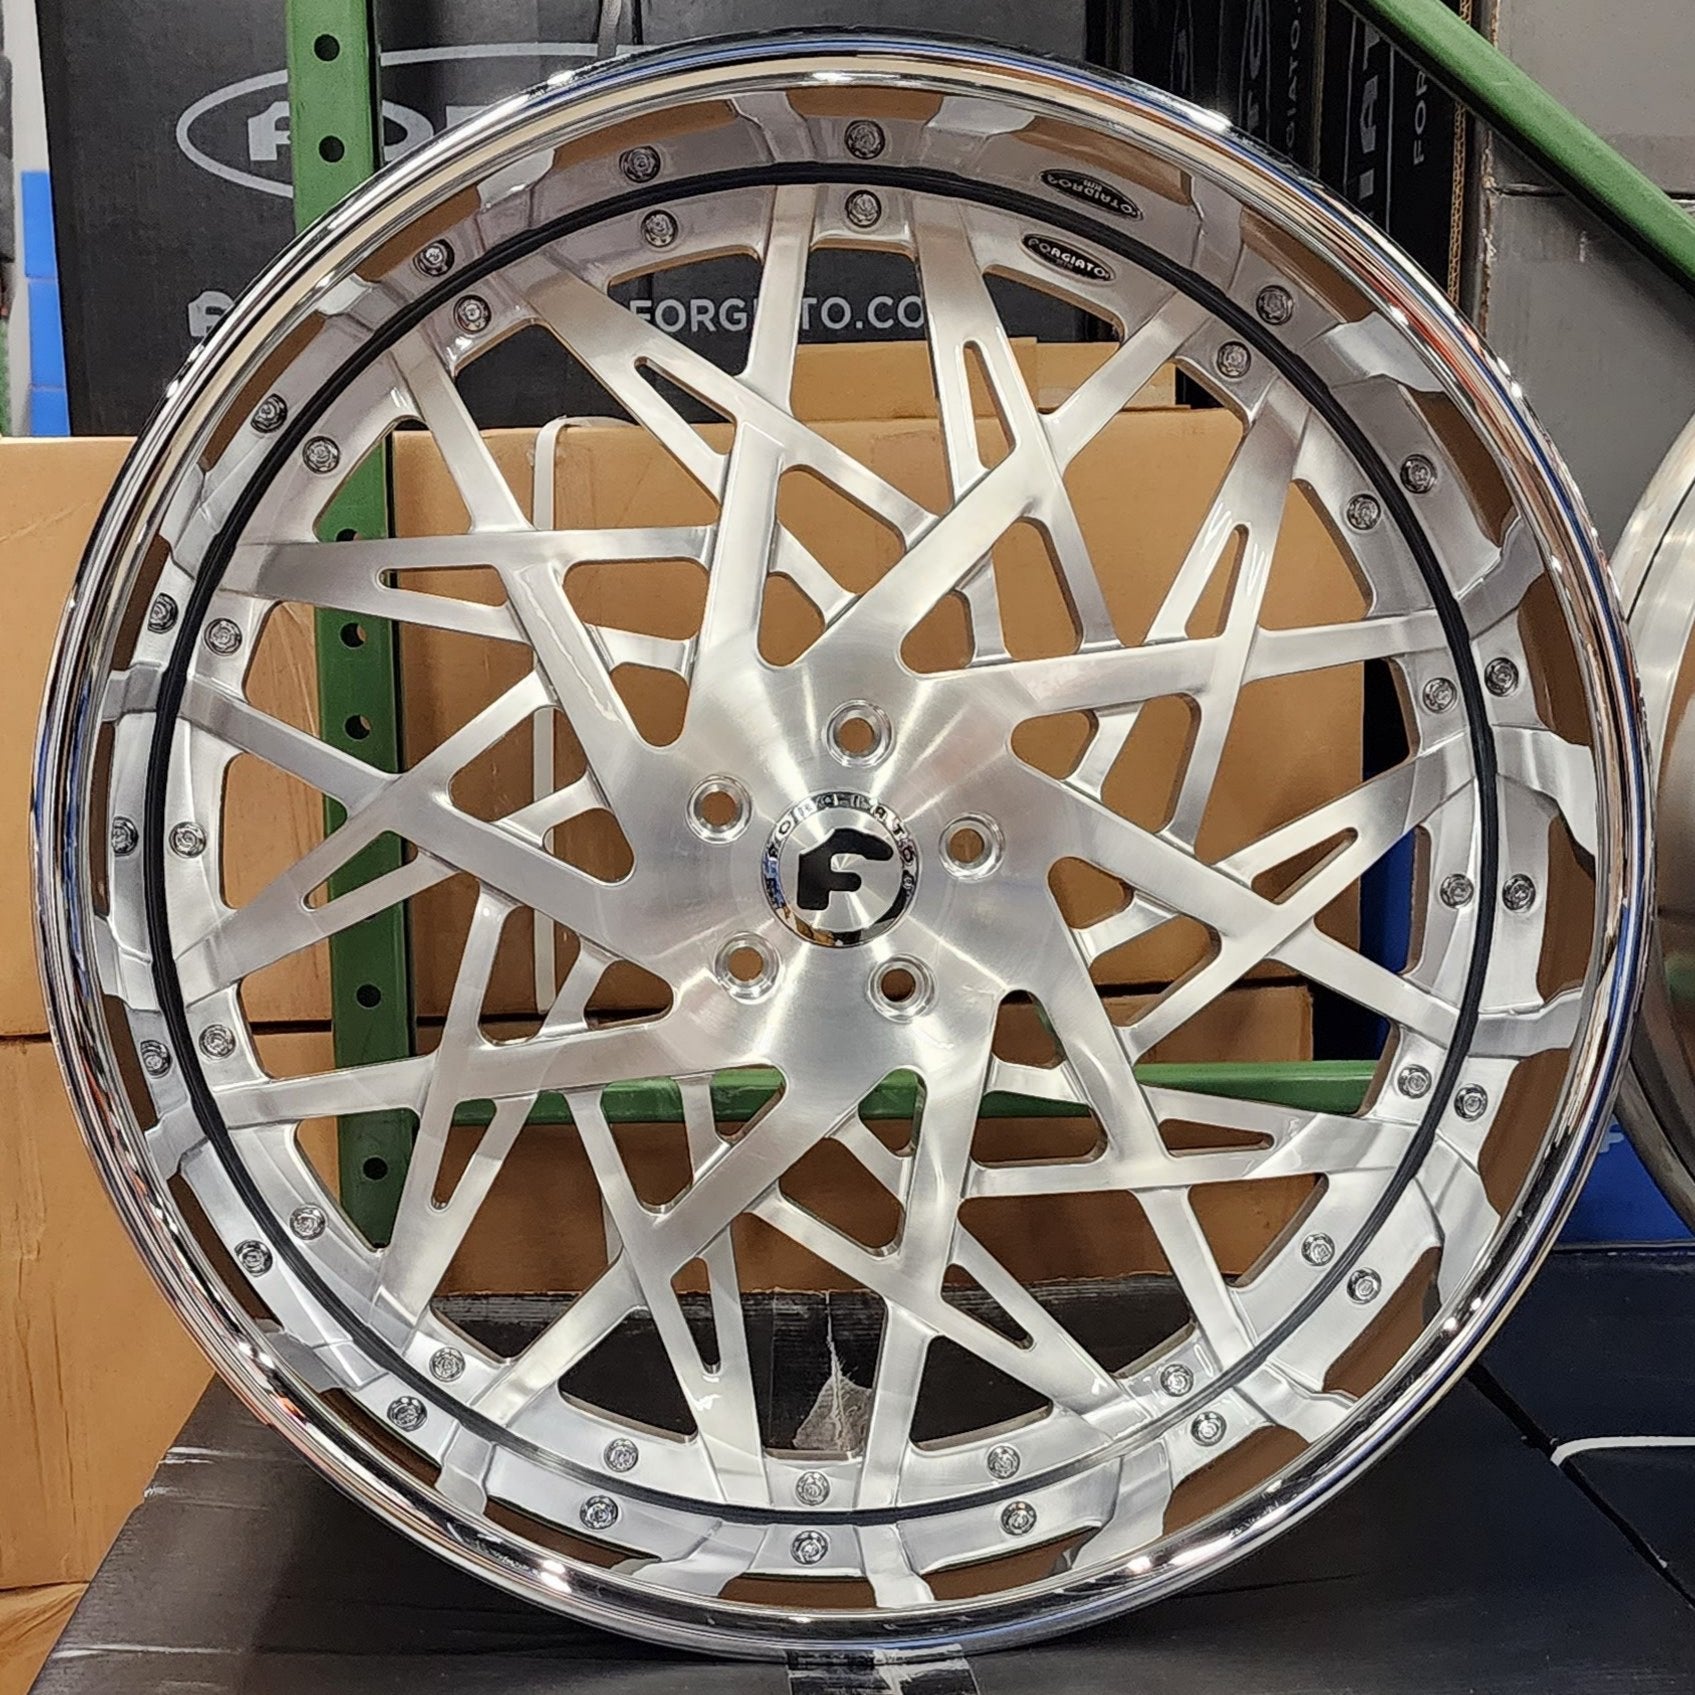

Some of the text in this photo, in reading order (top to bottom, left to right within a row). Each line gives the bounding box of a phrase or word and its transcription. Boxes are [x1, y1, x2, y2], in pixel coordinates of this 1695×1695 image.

[1027, 238, 1107, 277] FORGIATO
[629, 295, 925, 334] FORGTO.CO
[797, 827, 894, 911] F
